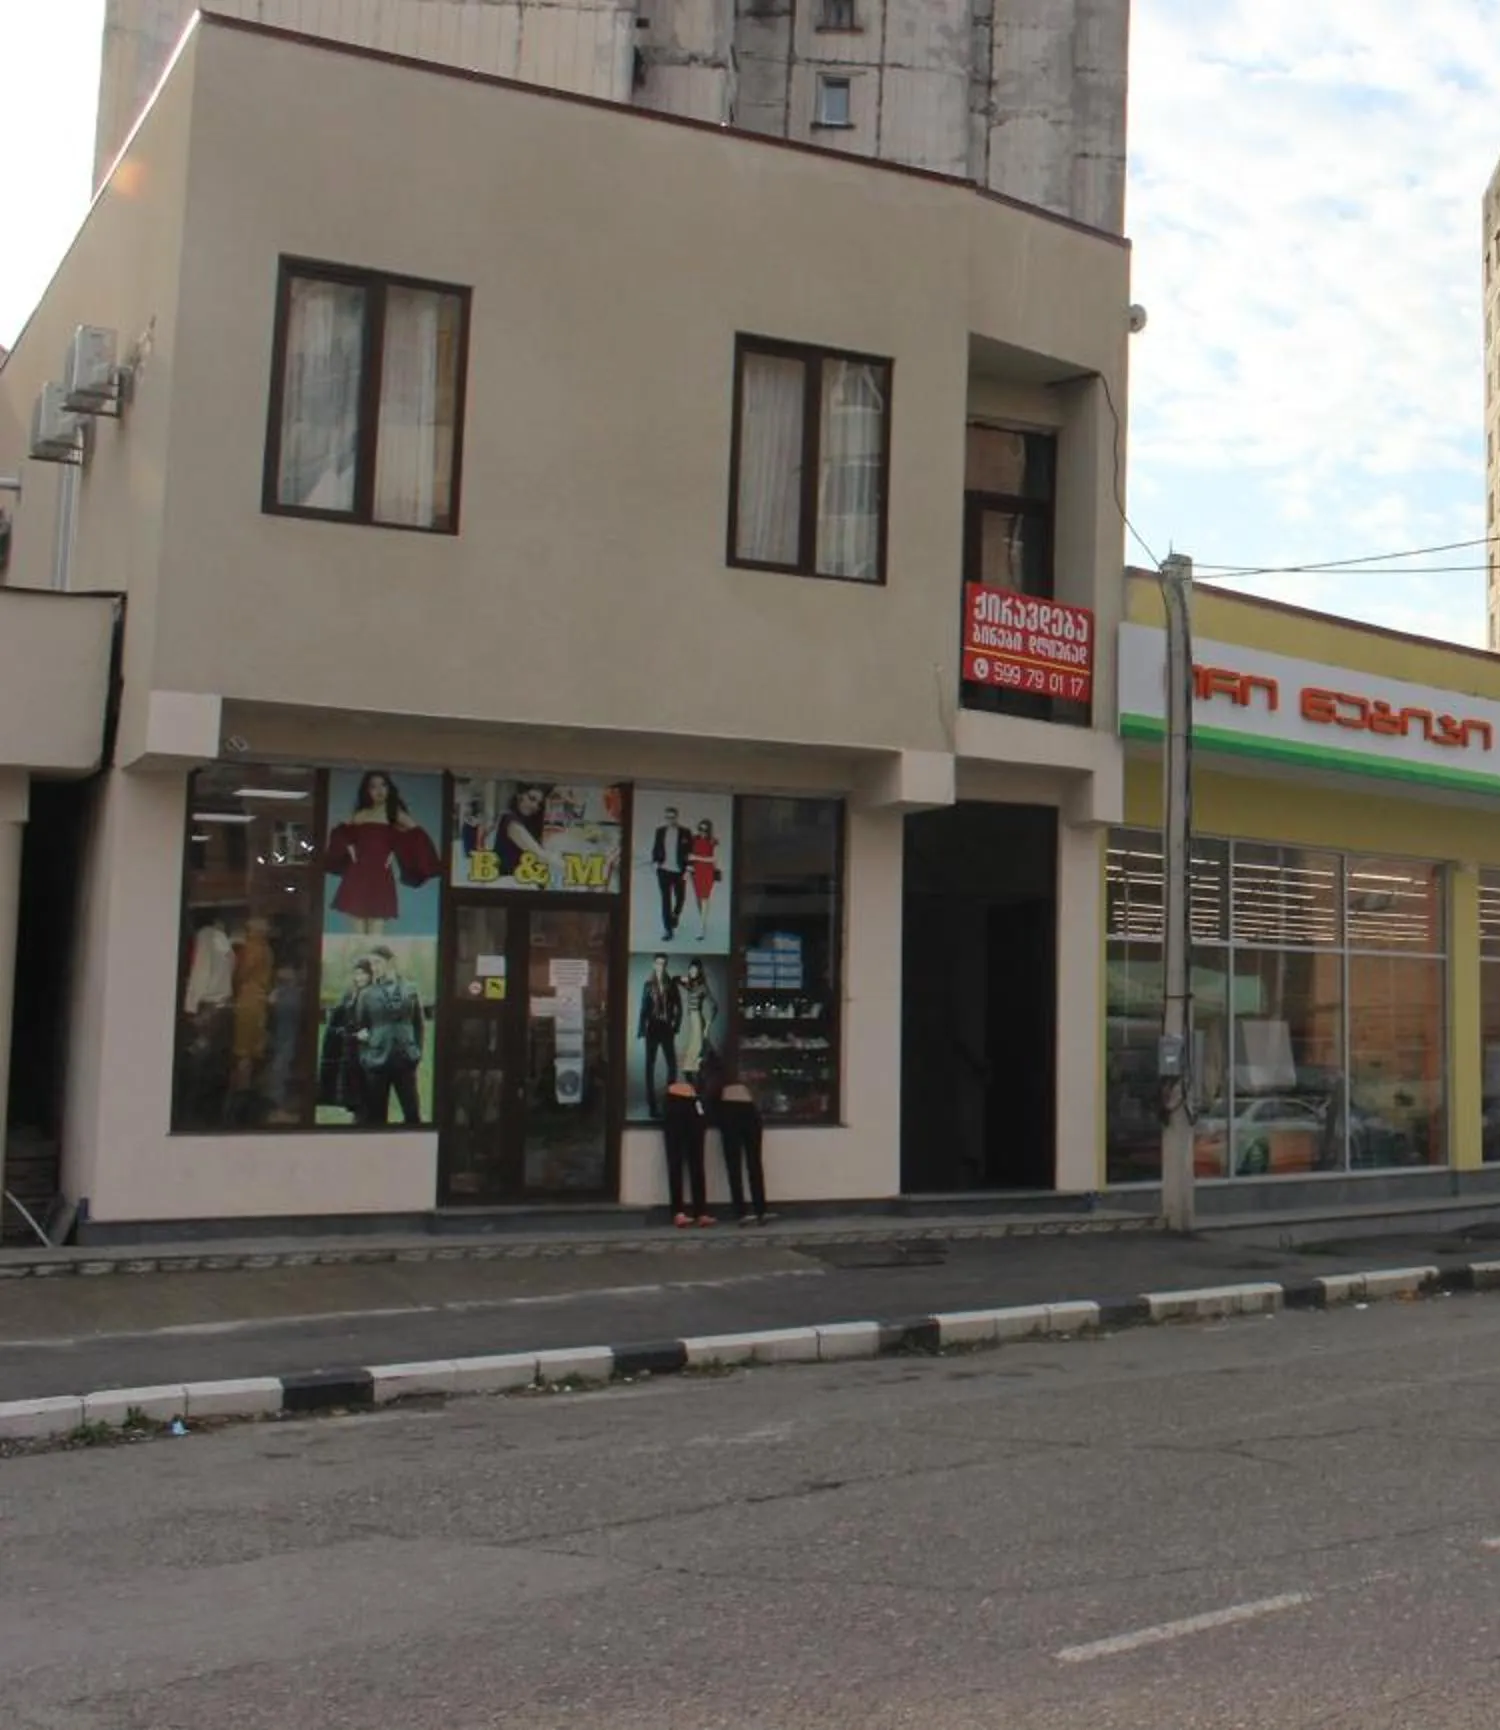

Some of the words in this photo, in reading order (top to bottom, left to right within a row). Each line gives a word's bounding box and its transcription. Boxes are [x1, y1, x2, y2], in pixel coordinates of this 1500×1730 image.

[973, 591, 1088, 643] ქირავდება
[973, 624, 1022, 650] ბინები
[993, 661, 1021, 685] 599
[1025, 668, 1045, 689] 79
[1049, 673, 1063, 694] 01
[1070, 676, 1085, 697] 17
[1192, 664, 1280, 711] რი
[1300, 687, 1493, 751] ნაბიჯი
[469, 851, 500, 882] B
[514, 851, 549, 884] &
[563, 853, 609, 887] M
